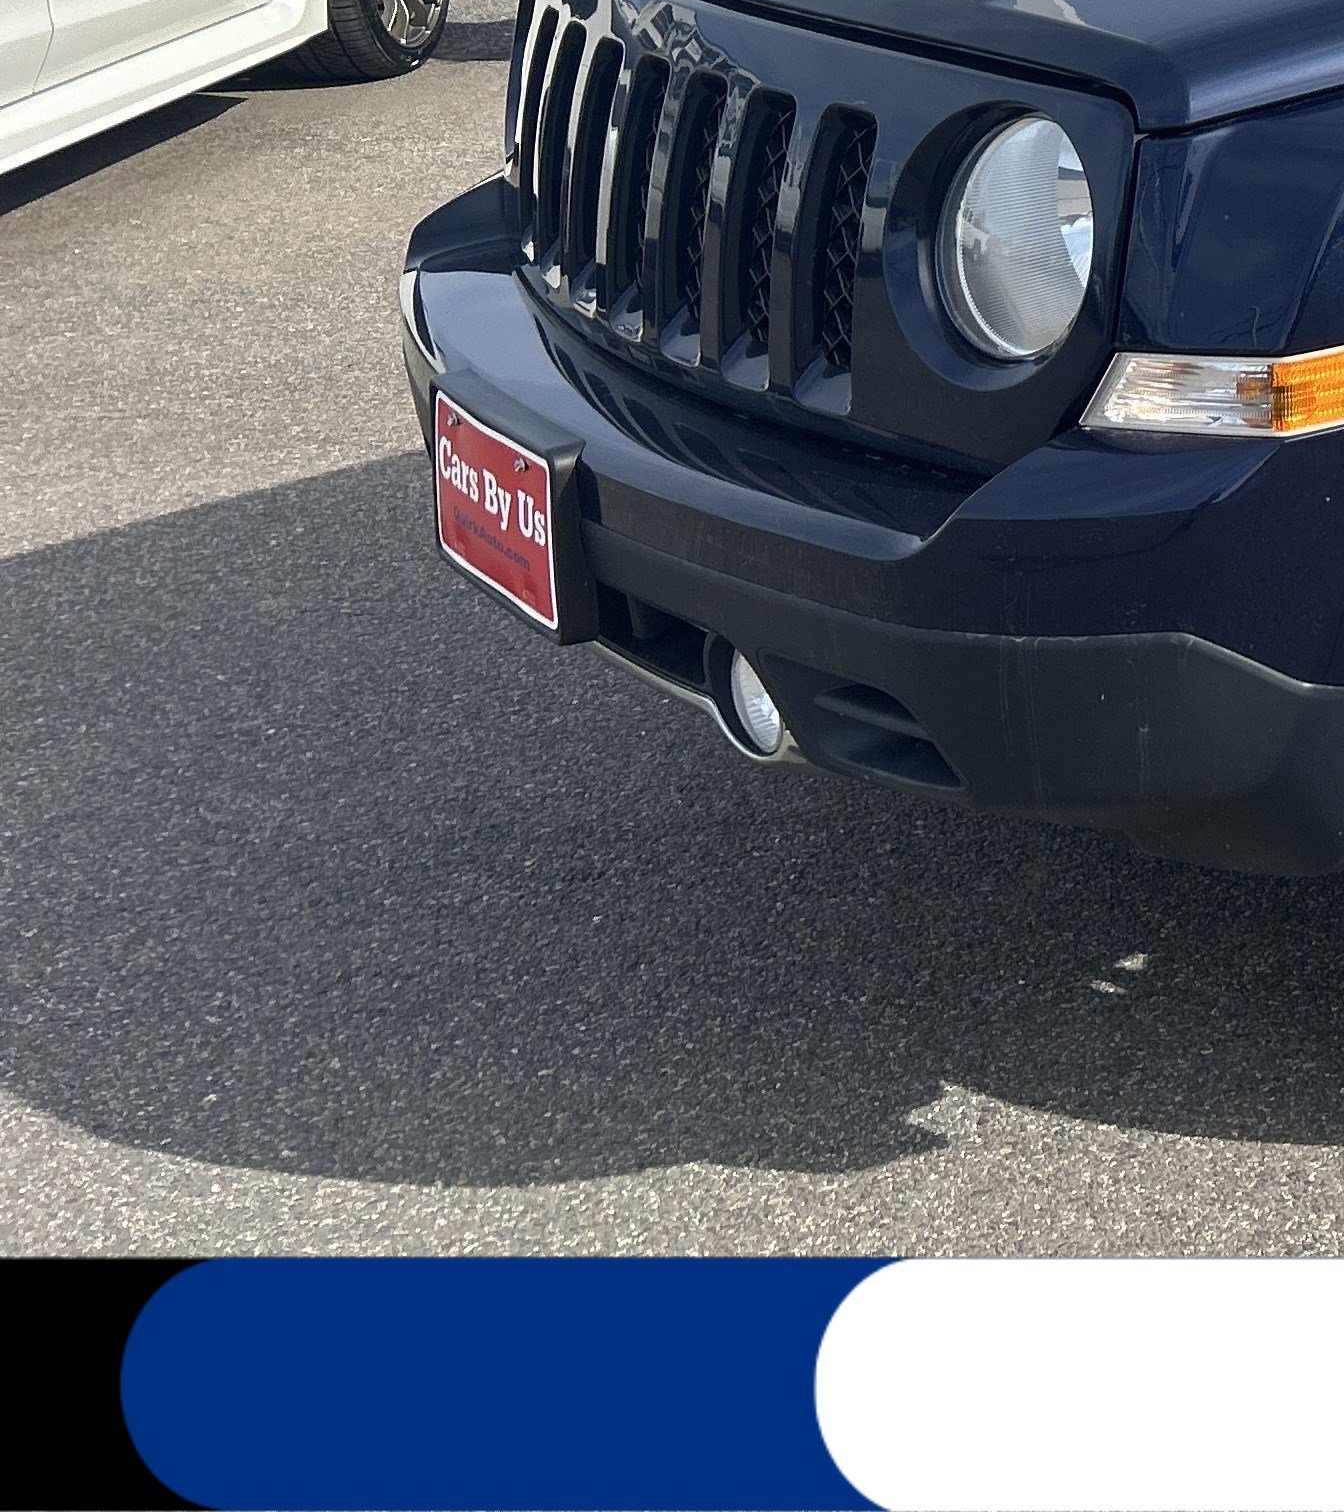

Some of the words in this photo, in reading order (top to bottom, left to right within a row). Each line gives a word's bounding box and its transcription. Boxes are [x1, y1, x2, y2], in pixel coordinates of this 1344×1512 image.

[438, 434, 480, 504] Cars
[482, 468, 512, 532] By
[516, 488, 547, 548] Us
